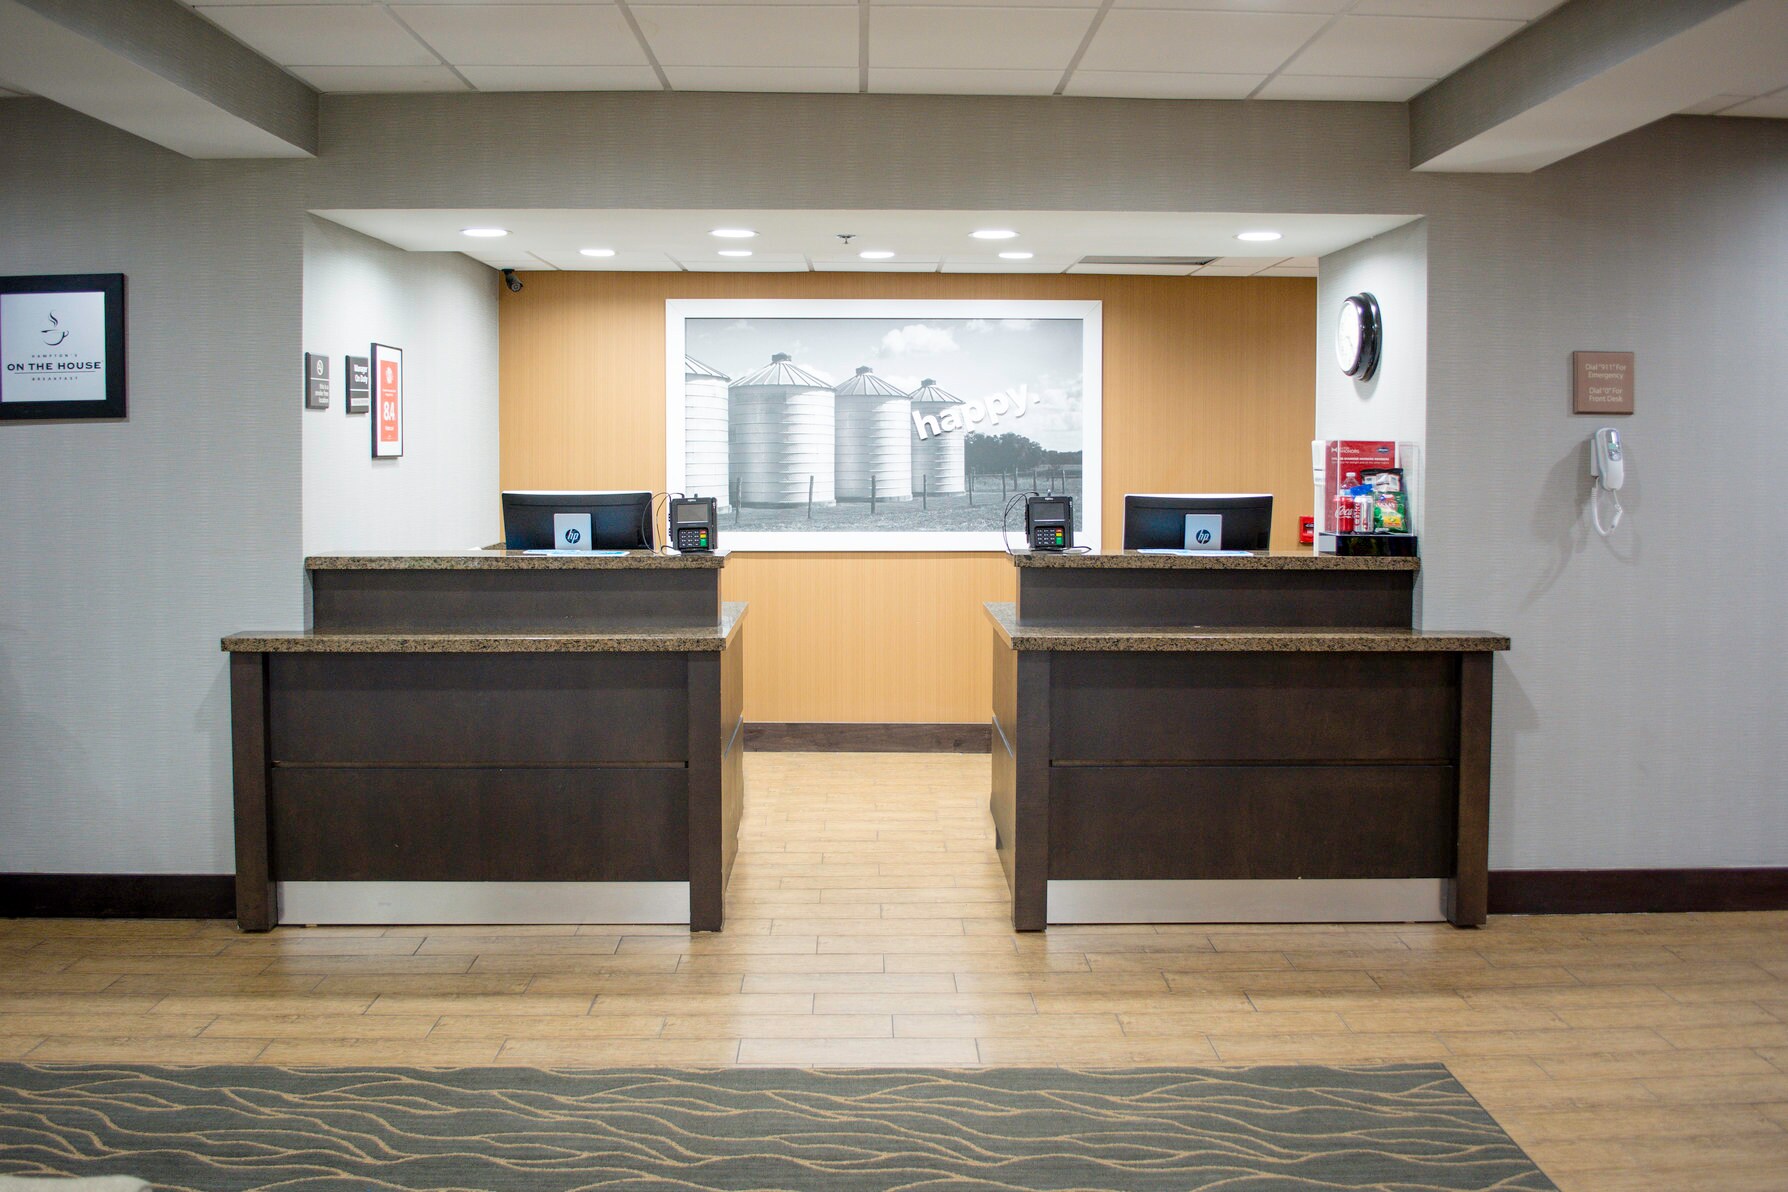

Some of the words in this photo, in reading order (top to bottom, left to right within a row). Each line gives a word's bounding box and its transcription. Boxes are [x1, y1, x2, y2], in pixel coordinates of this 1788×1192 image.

[7, 363, 25, 371] ON
[28, 362, 53, 371] THE
[57, 361, 101, 370] HOUSE
[1585, 363, 1598, 371] Dial
[1616, 363, 1627, 371] For
[1588, 371, 1624, 380] Emergency
[567, 529, 580, 544] hp
[1197, 529, 1210, 544] hp
